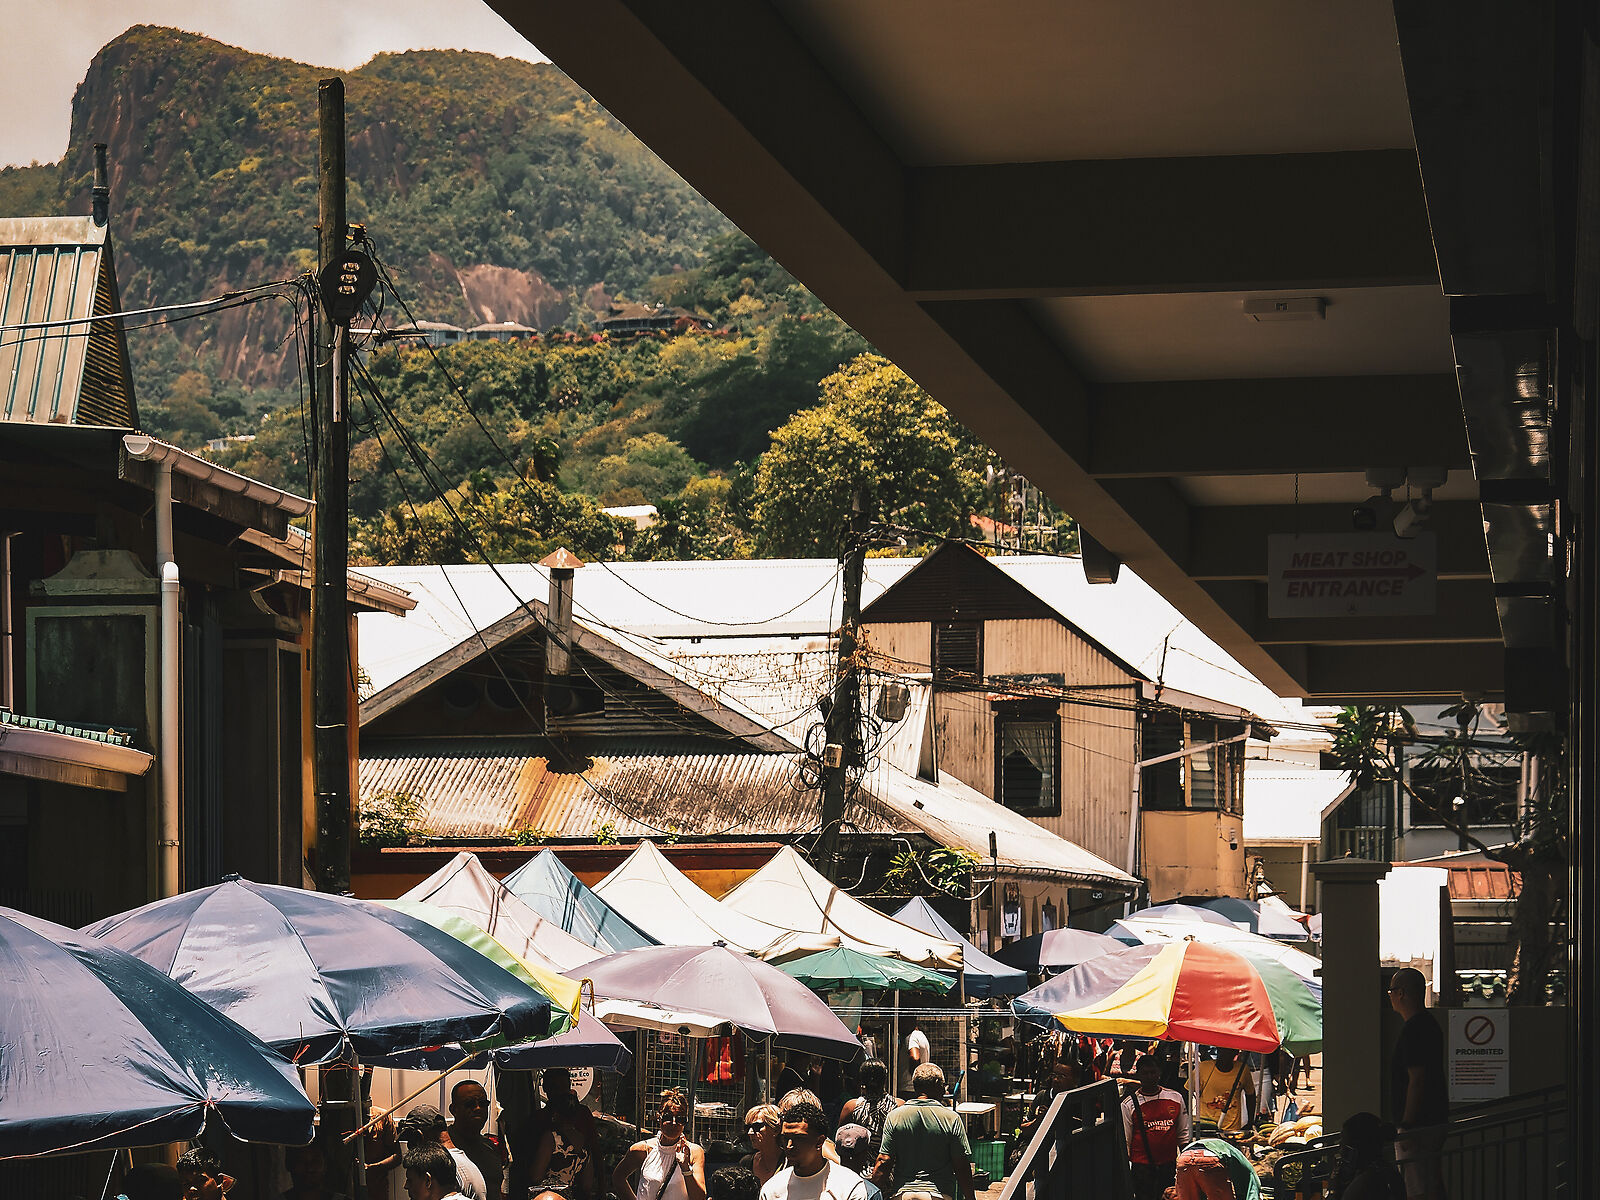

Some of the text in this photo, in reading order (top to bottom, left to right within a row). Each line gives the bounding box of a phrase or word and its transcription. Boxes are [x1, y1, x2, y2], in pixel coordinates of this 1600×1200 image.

[1292, 550, 1407, 568] MEAT SHOP
[1287, 579, 1404, 598] ENTRANCE
